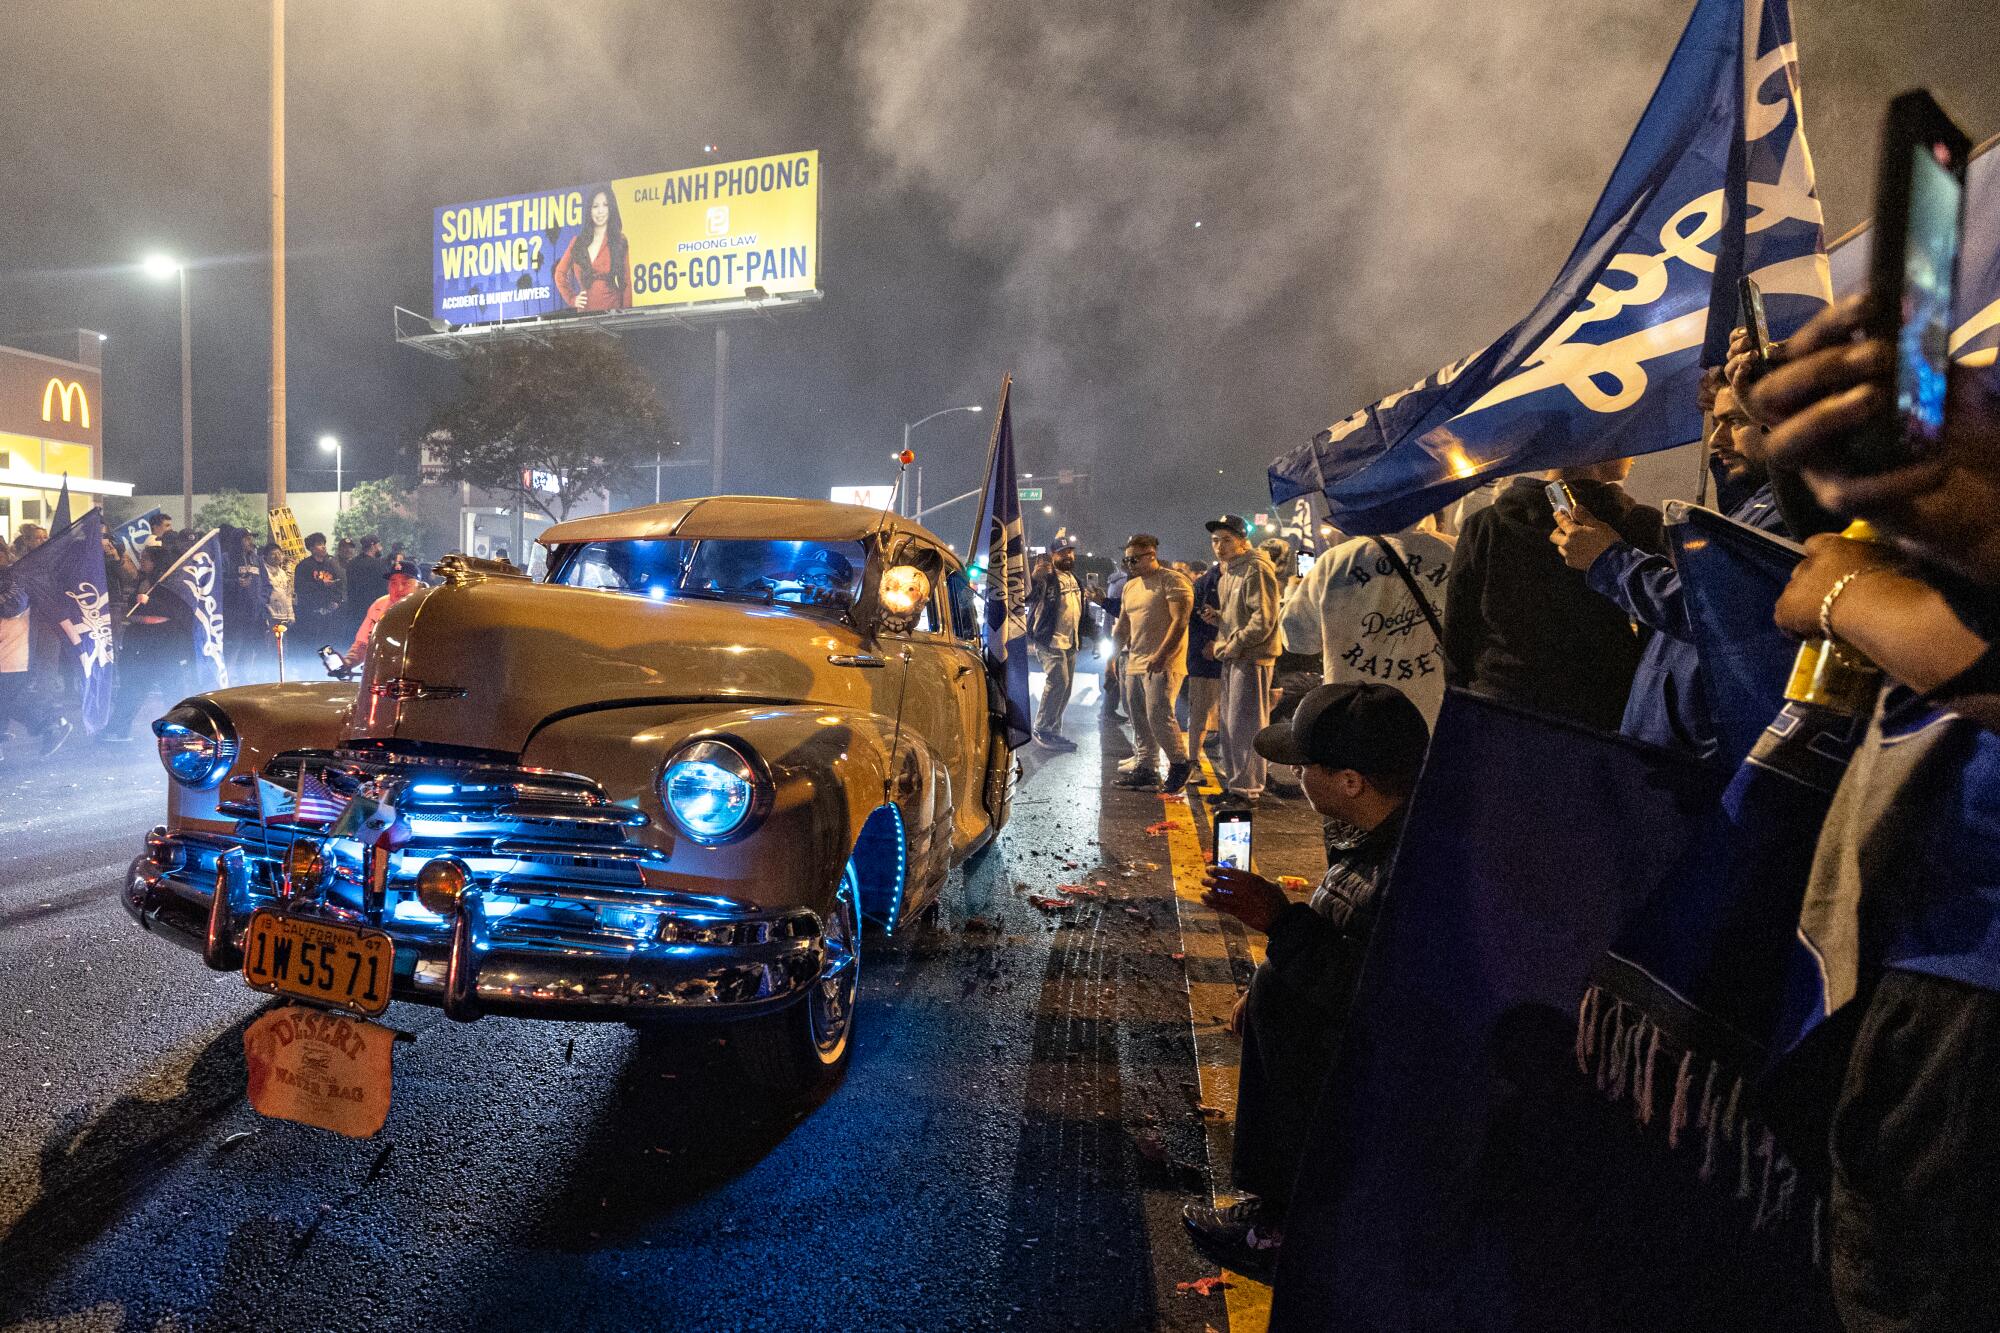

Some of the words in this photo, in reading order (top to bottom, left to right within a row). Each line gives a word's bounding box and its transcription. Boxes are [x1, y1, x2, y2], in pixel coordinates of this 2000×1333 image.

[634, 187, 660, 203] CALL
[662, 172, 709, 206] ANH
[713, 157, 810, 199] PHOONG
[441, 191, 584, 244] SOMETHING
[441, 235, 543, 281] WRONG?
[678, 237, 728, 252] PHOONG
[730, 235, 757, 247] LAW
[633, 245, 807, 295] 866-GOT-PAIN
[442, 293, 478, 310] ACCIDENT
[479, 293, 486, 306] &
[514, 286, 551, 301] LAWYERS
[1351, 553, 1449, 588] BORN
[1361, 601, 1443, 638] Dodges
[282, 923, 354, 946] CALIFORNIA
[269, 1013, 367, 1061] DESERT
